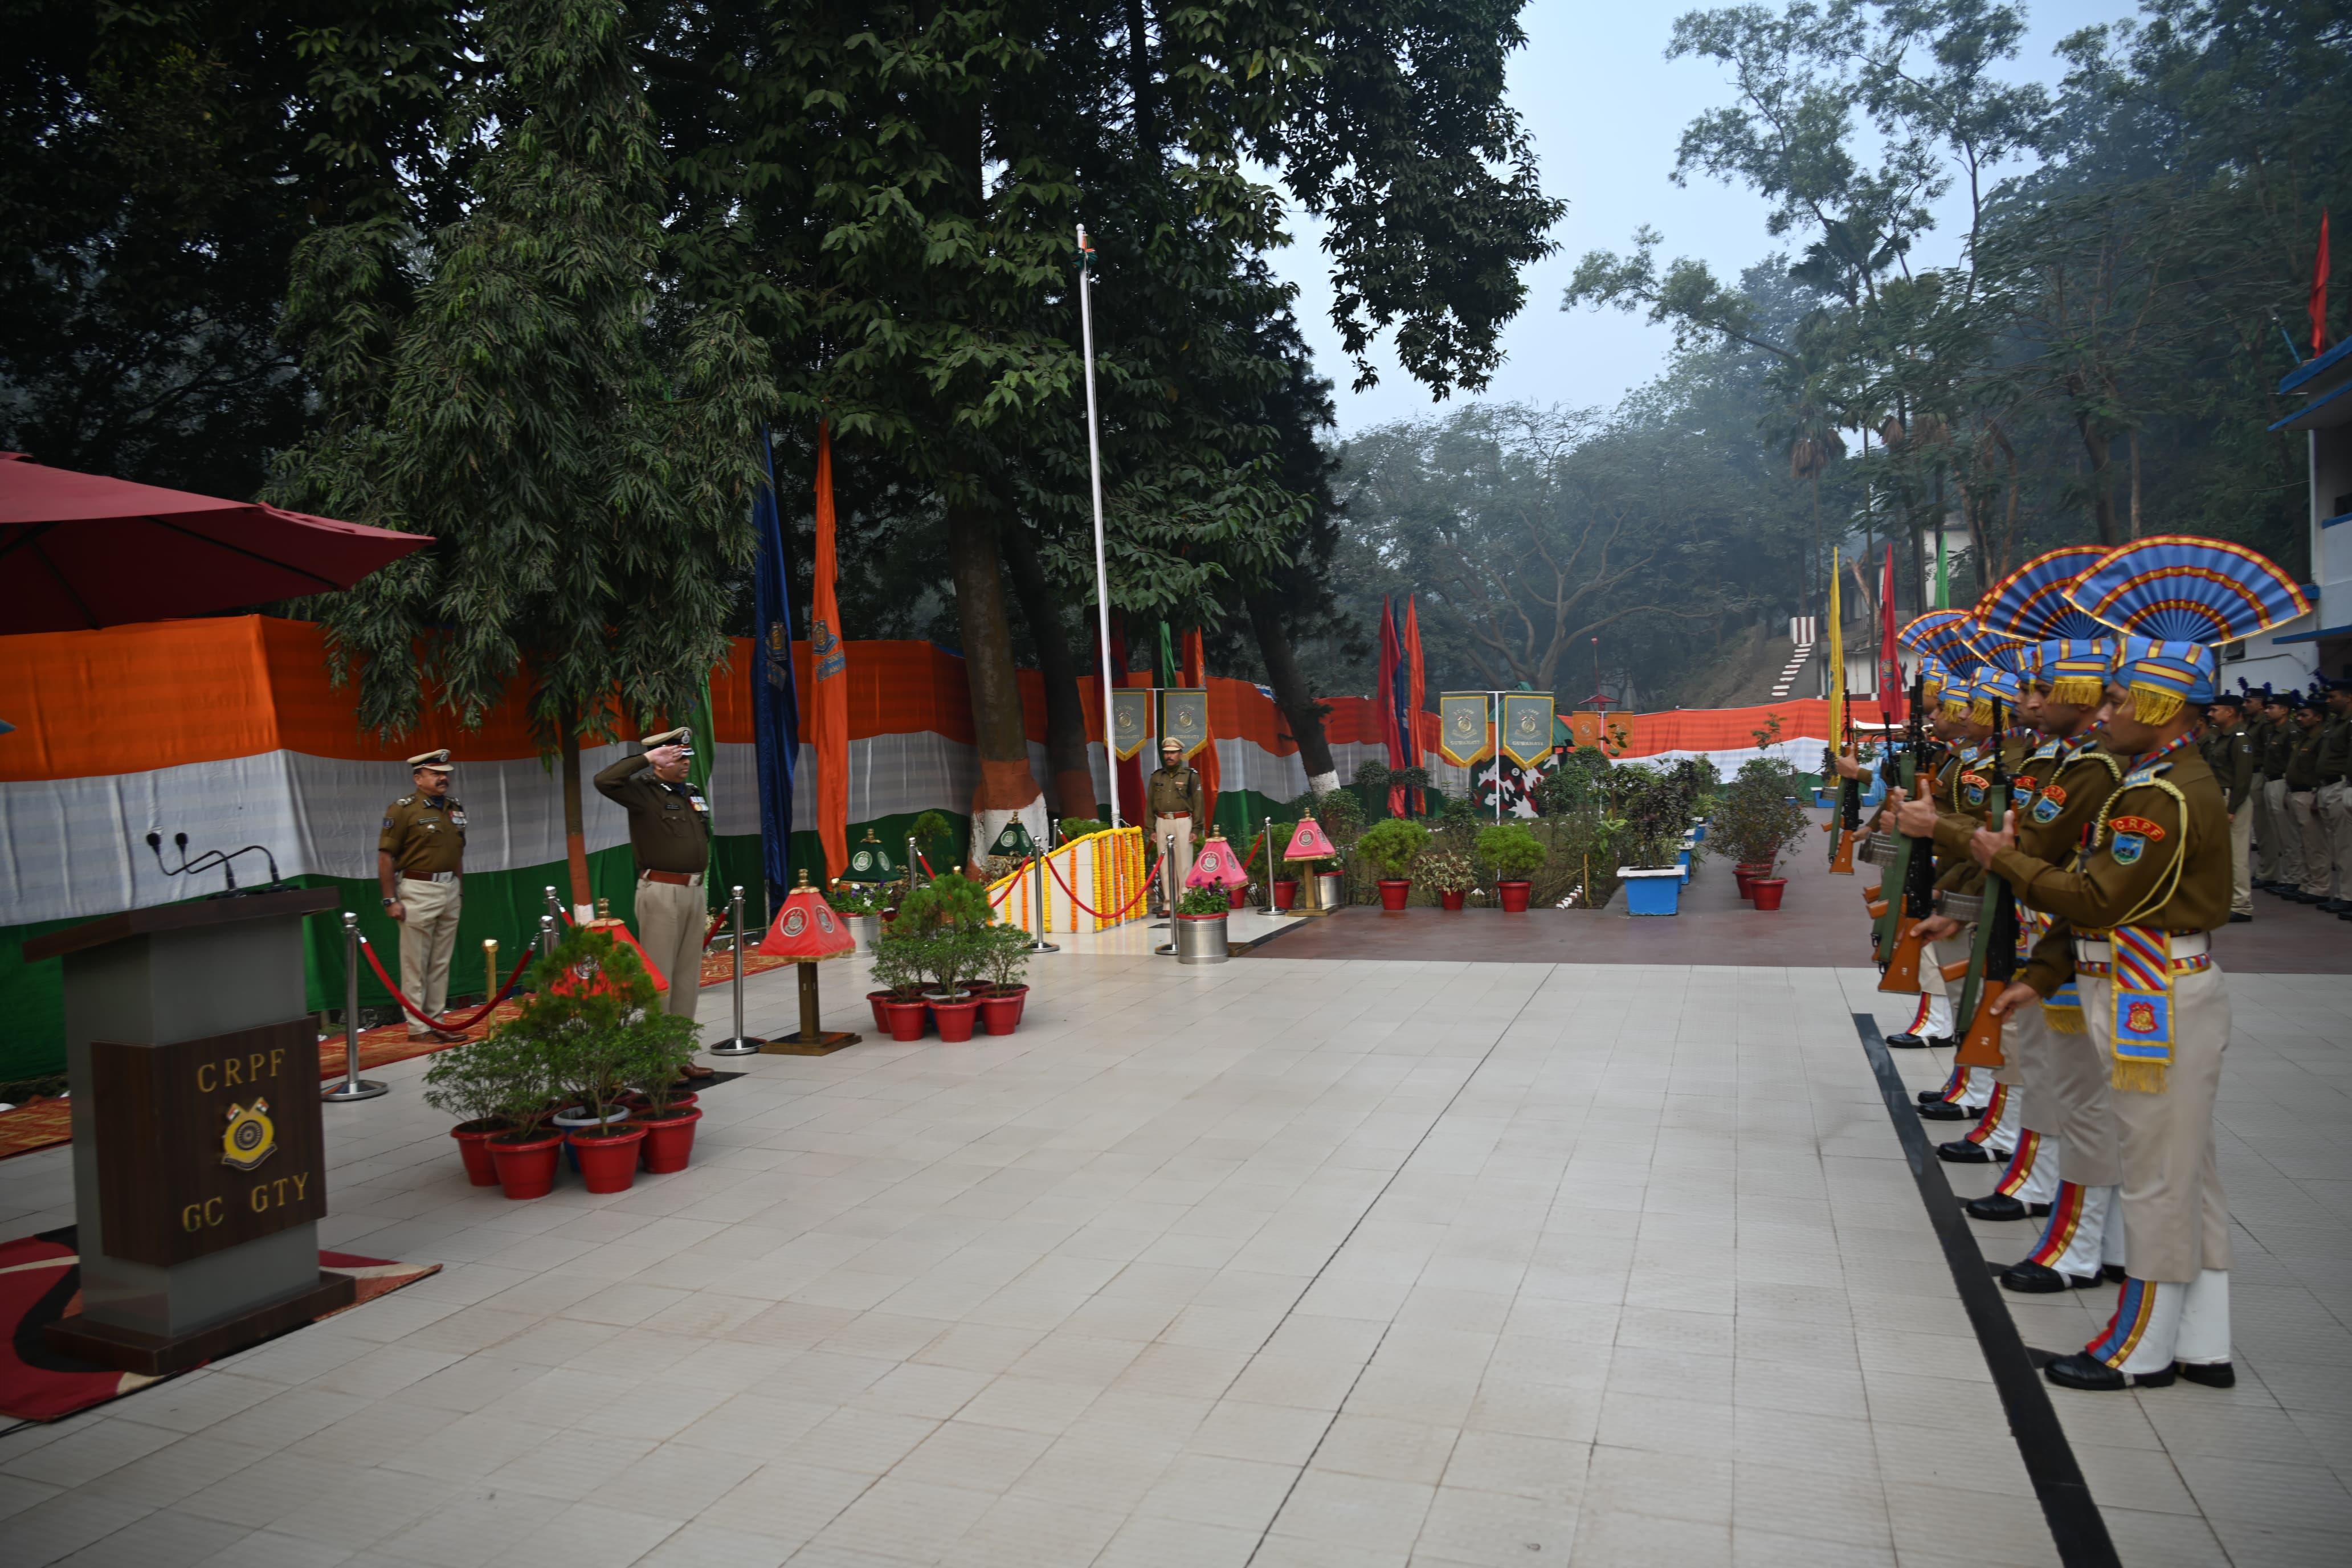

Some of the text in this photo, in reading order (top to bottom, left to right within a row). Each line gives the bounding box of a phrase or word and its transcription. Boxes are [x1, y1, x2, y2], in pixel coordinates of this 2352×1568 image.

[197, 1048, 286, 1093] CRPF
[182, 1172, 309, 1232] GC GTY
